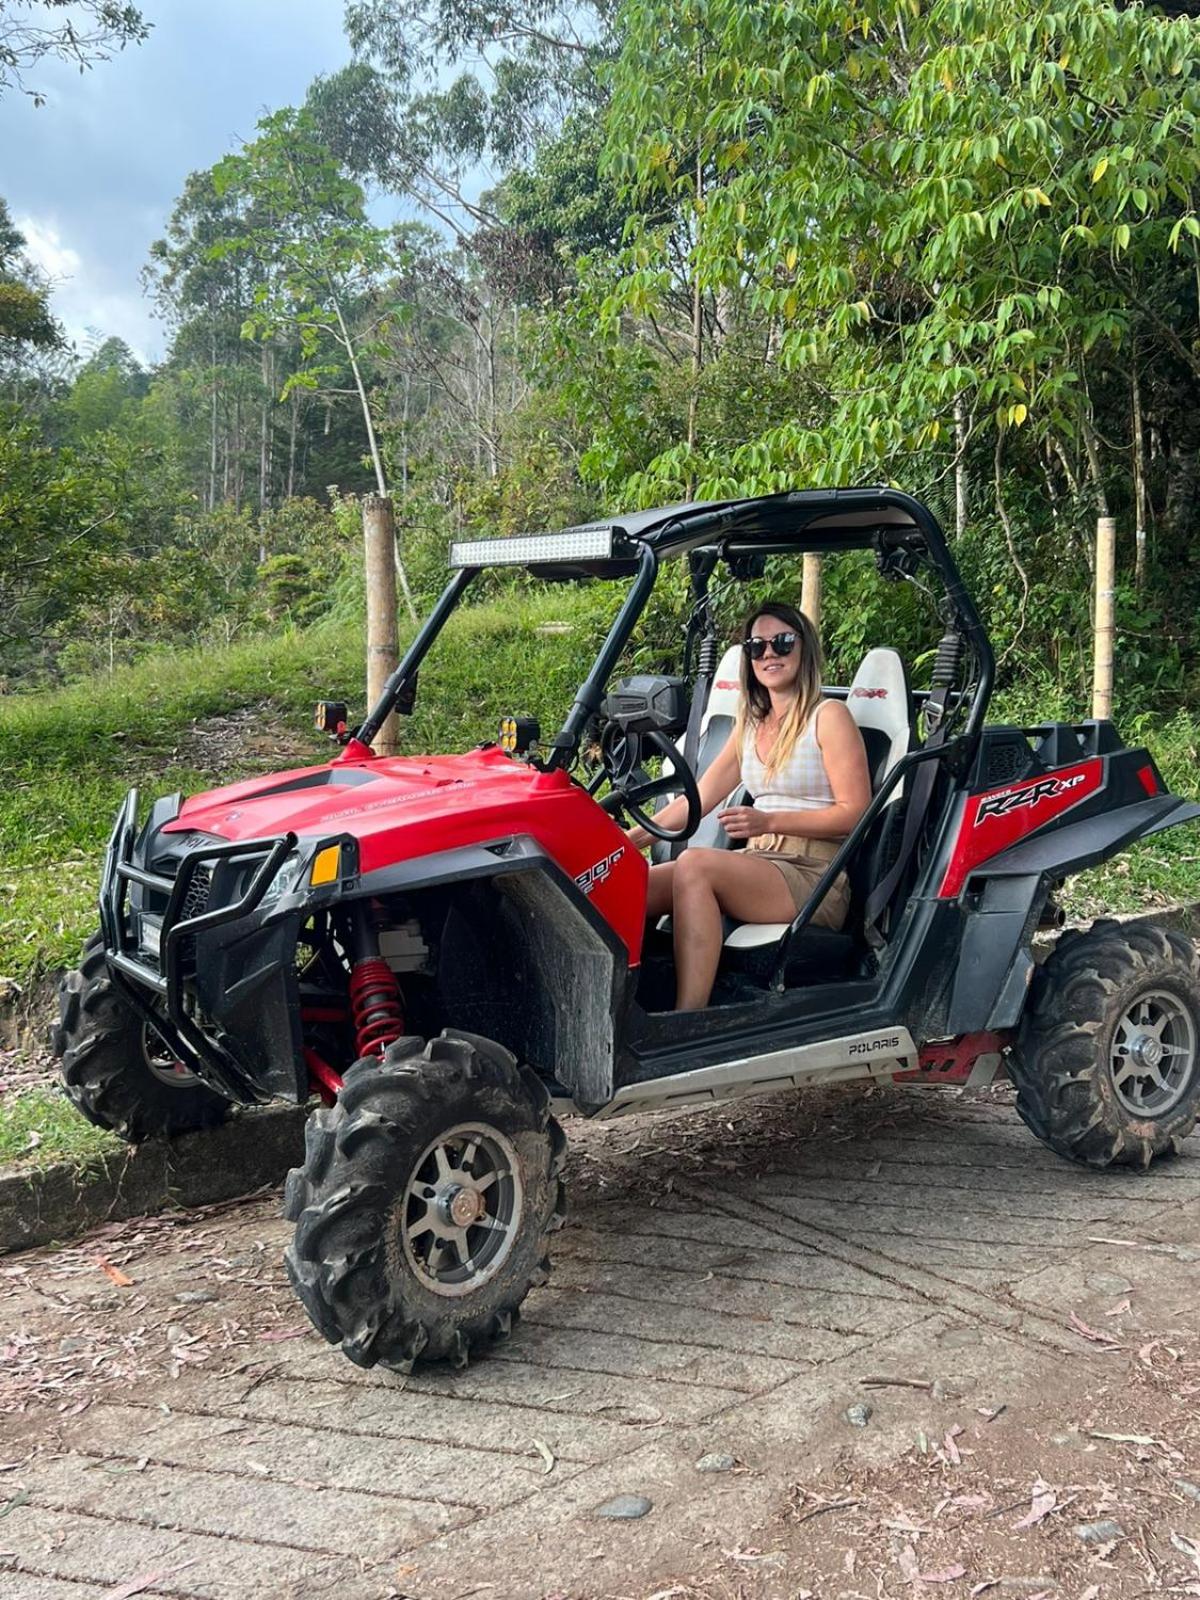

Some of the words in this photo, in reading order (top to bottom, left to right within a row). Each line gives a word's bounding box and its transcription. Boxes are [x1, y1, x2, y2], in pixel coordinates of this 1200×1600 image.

[974, 777, 1062, 828] RZR
[1060, 774, 1086, 791] XP
[848, 1037, 900, 1056] POLARIS
